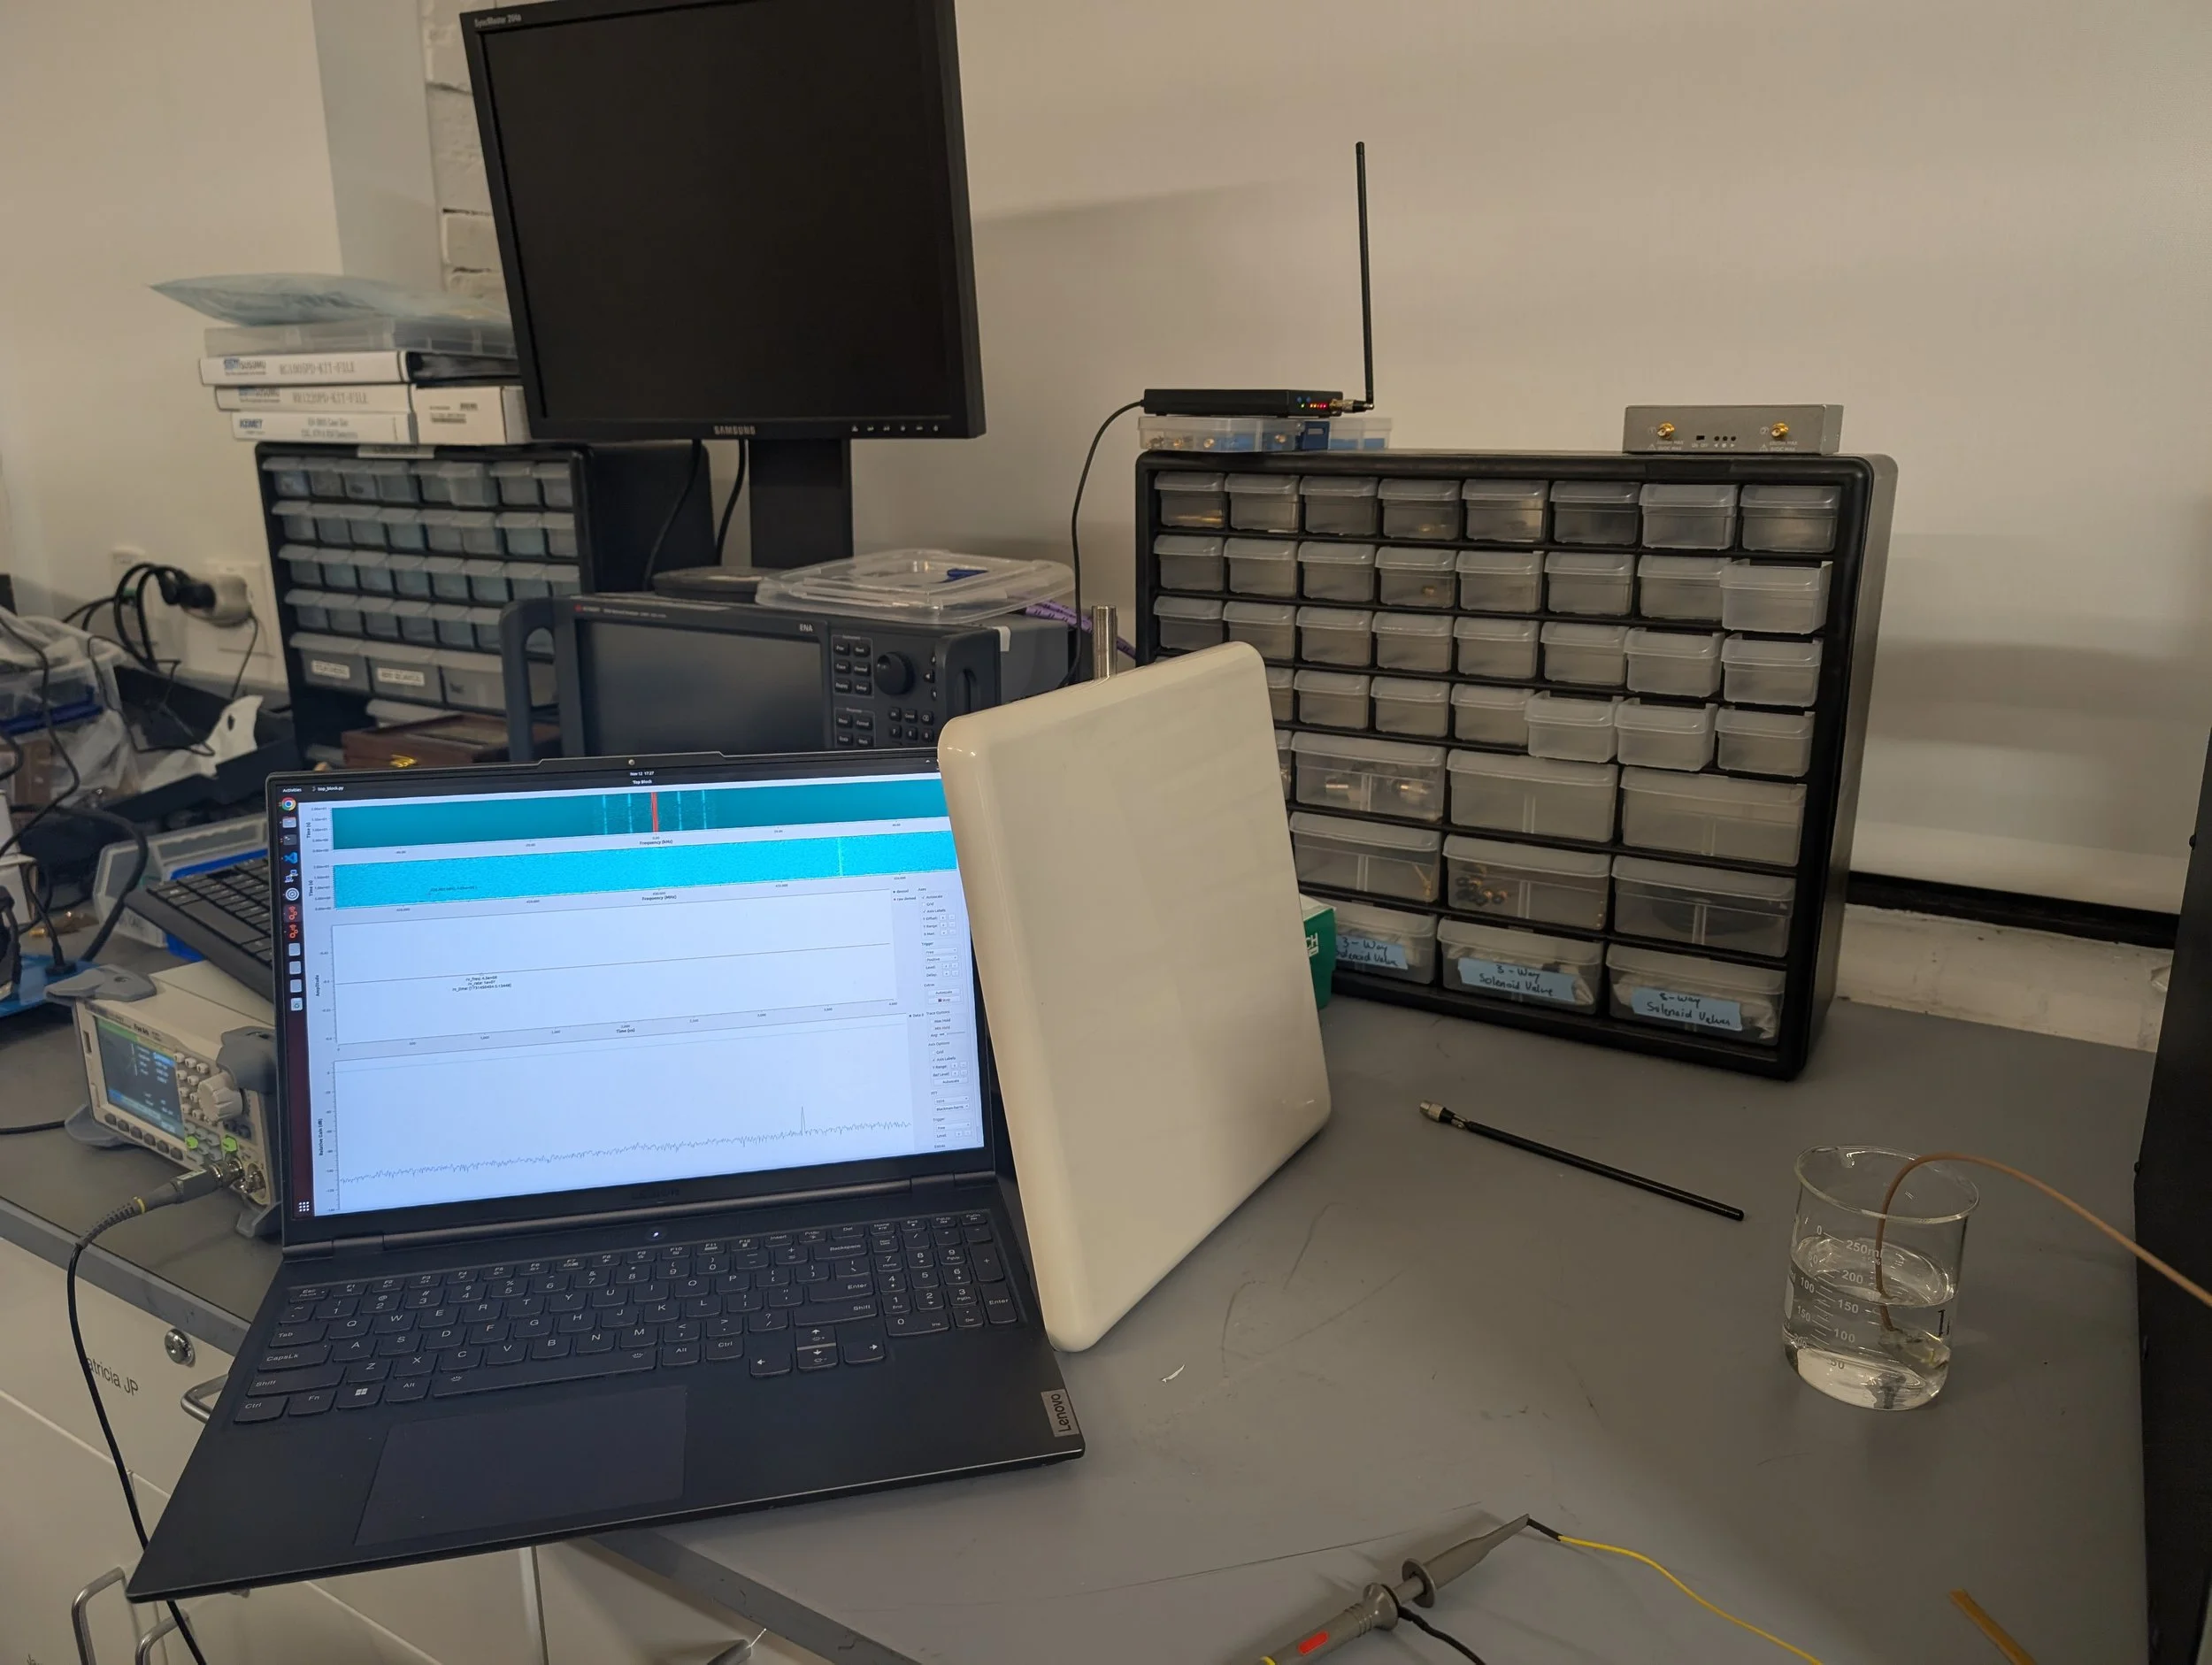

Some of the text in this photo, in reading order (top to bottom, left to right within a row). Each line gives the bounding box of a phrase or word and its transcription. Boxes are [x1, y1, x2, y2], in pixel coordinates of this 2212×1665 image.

[714, 426, 756, 435] SAMSUNG
[800, 624, 813, 633] ENA
[1479, 972, 1520, 990] Solenoid
[1647, 1001, 1693, 1018] Solenoid
[1800, 1277, 1815, 1293] 100
[1841, 1270, 1863, 1285] 200
[1797, 1305, 1811, 1322] 150
[1838, 1299, 1859, 1314] 150
[1833, 1327, 1855, 1343] 100
[87, 1357, 139, 1396] atricia JP
[1050, 1393, 1071, 1432] Lenovo
